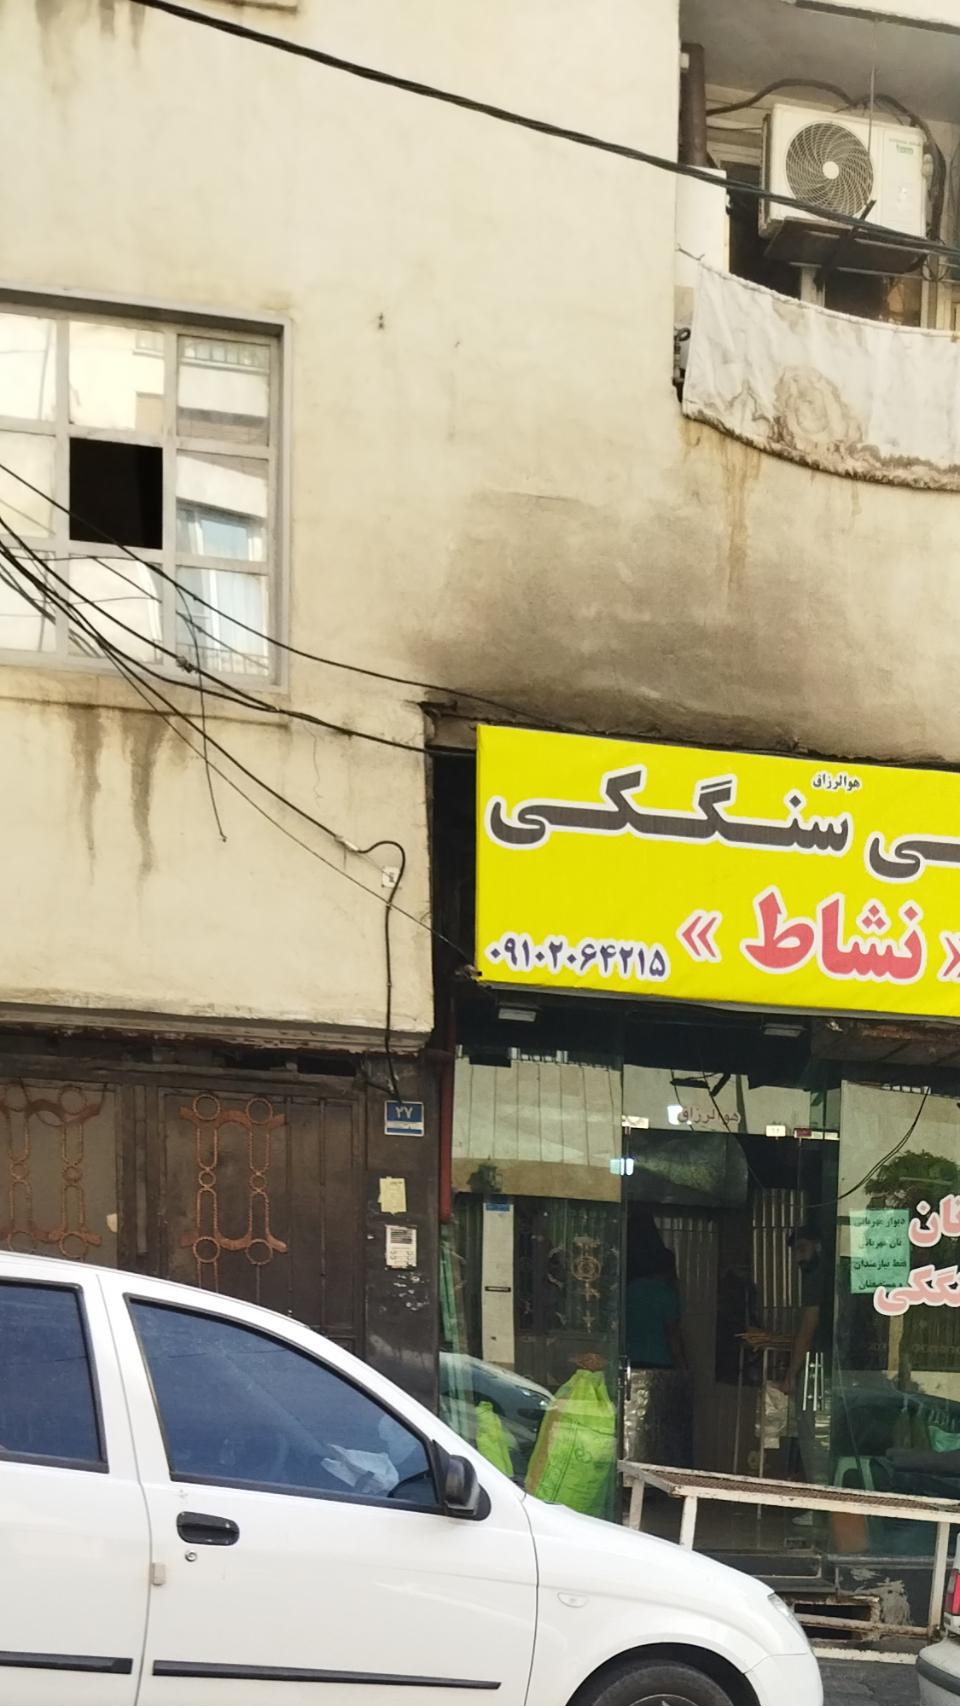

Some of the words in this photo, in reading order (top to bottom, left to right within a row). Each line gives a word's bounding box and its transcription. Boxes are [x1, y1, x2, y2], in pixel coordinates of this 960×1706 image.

[813, 773, 860, 791] هوالرزاق
[489, 770, 850, 852] سنگکی
[490, 937, 667, 978] ۰۹۱۰۲۰۶۴۲۱۵
[395, 1106, 413, 1119] ۲۷
